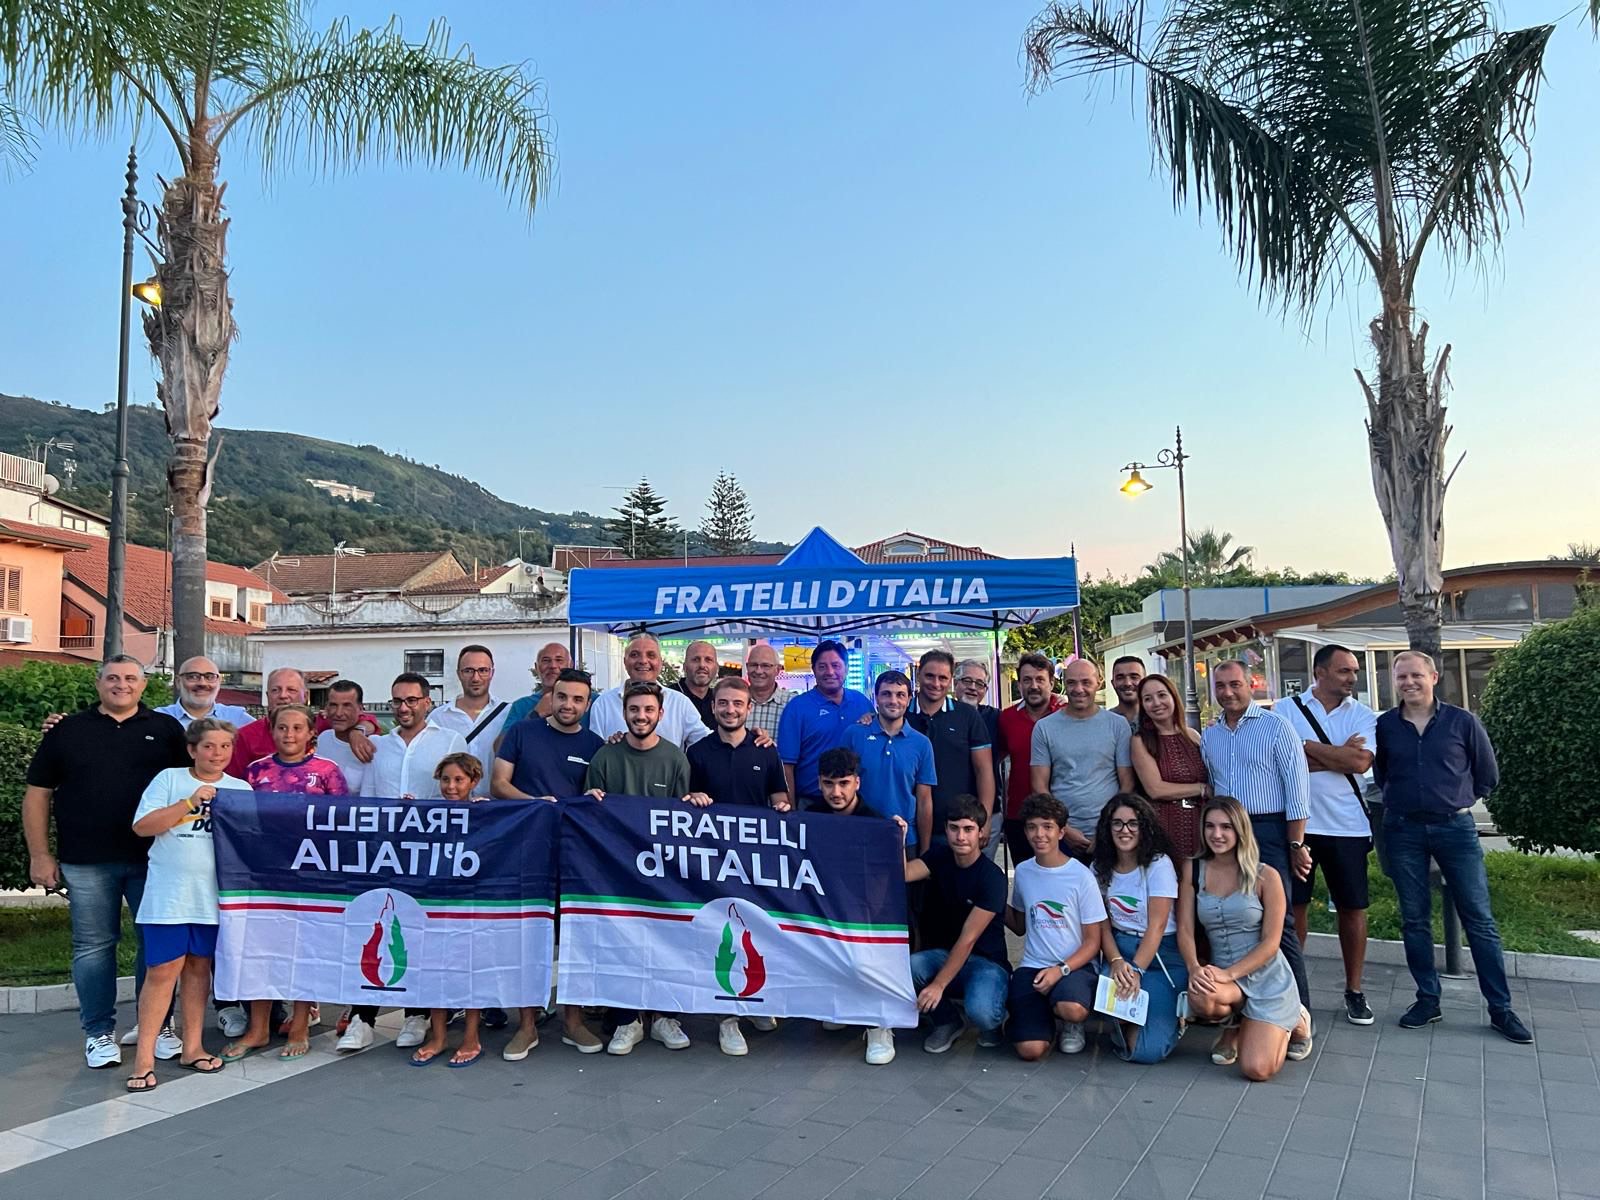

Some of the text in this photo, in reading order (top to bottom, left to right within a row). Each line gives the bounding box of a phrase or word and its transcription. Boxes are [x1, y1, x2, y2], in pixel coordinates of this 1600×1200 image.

[654, 577, 989, 615] FRATELLI D'ITALIA
[649, 809, 807, 850] FRATELLI
[635, 843, 826, 896] d'ITALIA
